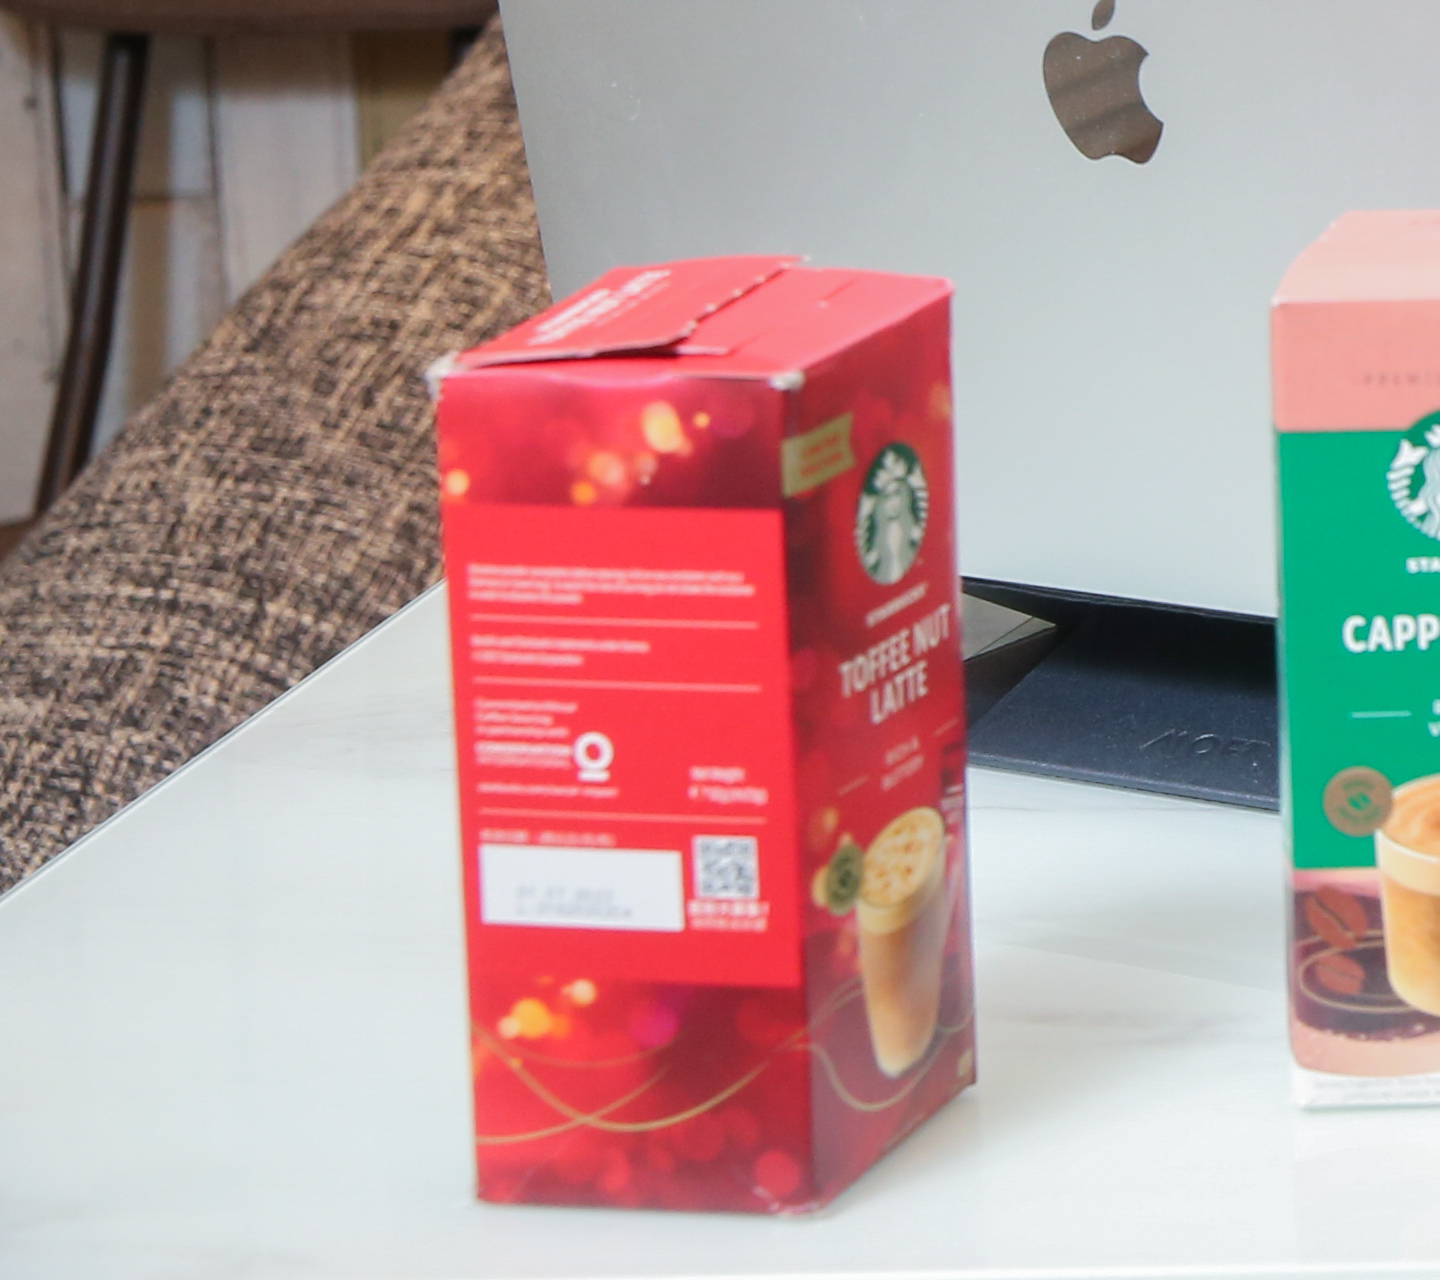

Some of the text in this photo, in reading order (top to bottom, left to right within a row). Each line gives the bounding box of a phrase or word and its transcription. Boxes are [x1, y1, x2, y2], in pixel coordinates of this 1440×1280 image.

[839, 627, 911, 698] TOFFEE
[912, 603, 951, 657] NUT
[870, 659, 929, 725] LATTE
